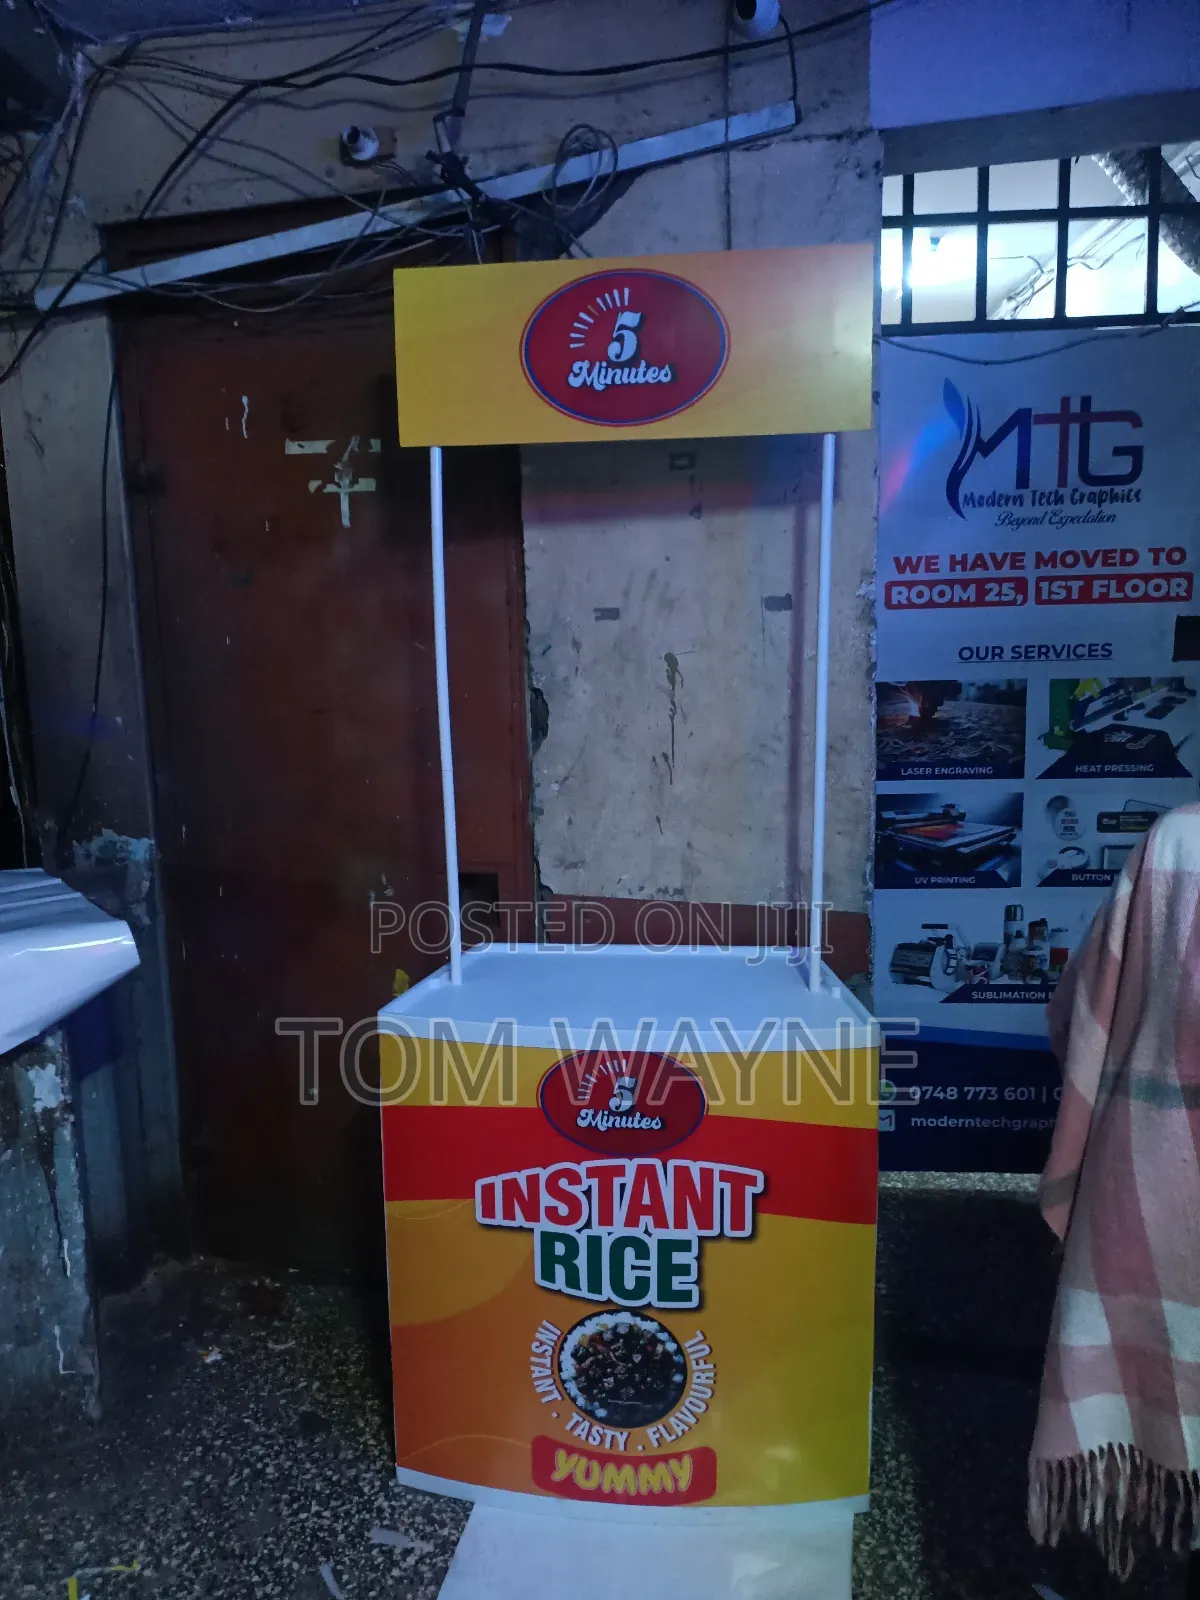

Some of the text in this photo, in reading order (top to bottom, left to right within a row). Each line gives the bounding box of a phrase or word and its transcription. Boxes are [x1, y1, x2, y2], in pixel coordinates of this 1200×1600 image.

[607, 311, 643, 362] 5
[567, 359, 674, 391] Minutes
[963, 487, 1142, 509] Modern Tech Graphics
[994, 508, 1117, 531] Beyond Expectation
[893, 546, 1187, 575] WE HAVE MOVED TO
[890, 577, 1188, 606] ROOM 25, 1ST FLOOR
[958, 642, 1113, 662] OUR SERVICES
[901, 765, 994, 776] LASER ENGRAVING
[1075, 763, 1154, 773] HEAT PRESSING
[914, 876, 976, 885] UV PRINTING
[1071, 873, 1111, 882] BUTTON
[971, 990, 1046, 1000] SUBLIMATION
[608, 1076, 638, 1112] 5
[909, 1086, 959, 1100] 0748
[963, 1086, 999, 1100] 773
[1003, 1086, 1036, 1100] 601
[576, 1108, 663, 1132] Minutes
[475, 1157, 764, 1238] INSTANT
[534, 1231, 700, 1309] RICE
[530, 1319, 716, 1451] INSTANT TASTY FLAVOURFUL
[551, 1448, 694, 1497] YUMMY
